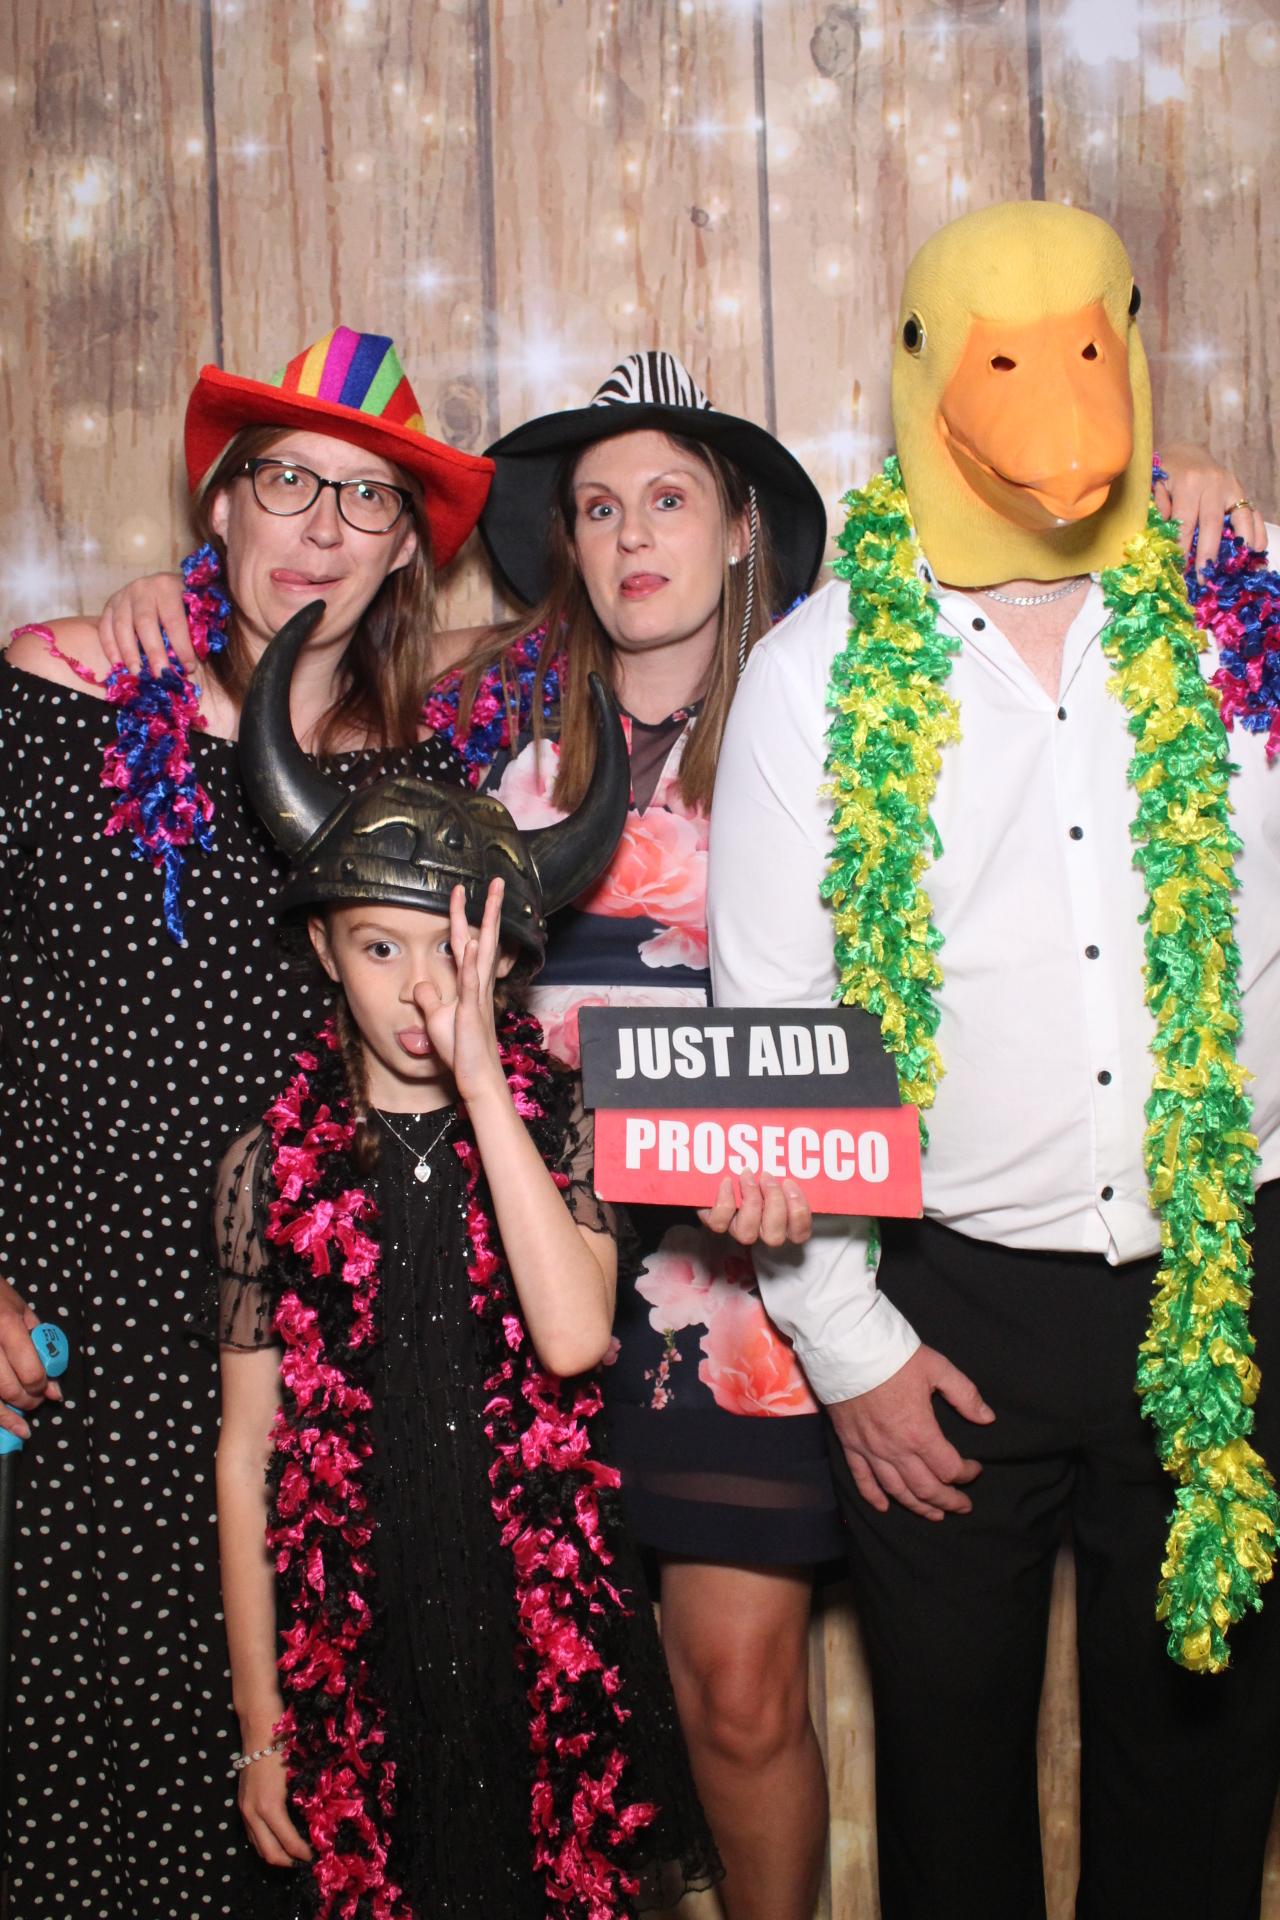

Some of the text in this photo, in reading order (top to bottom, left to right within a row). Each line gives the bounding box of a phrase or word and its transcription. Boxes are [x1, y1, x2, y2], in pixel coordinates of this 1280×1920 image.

[616, 1025, 850, 1080] JUST ADD
[625, 1118, 890, 1183] PROSECCO
